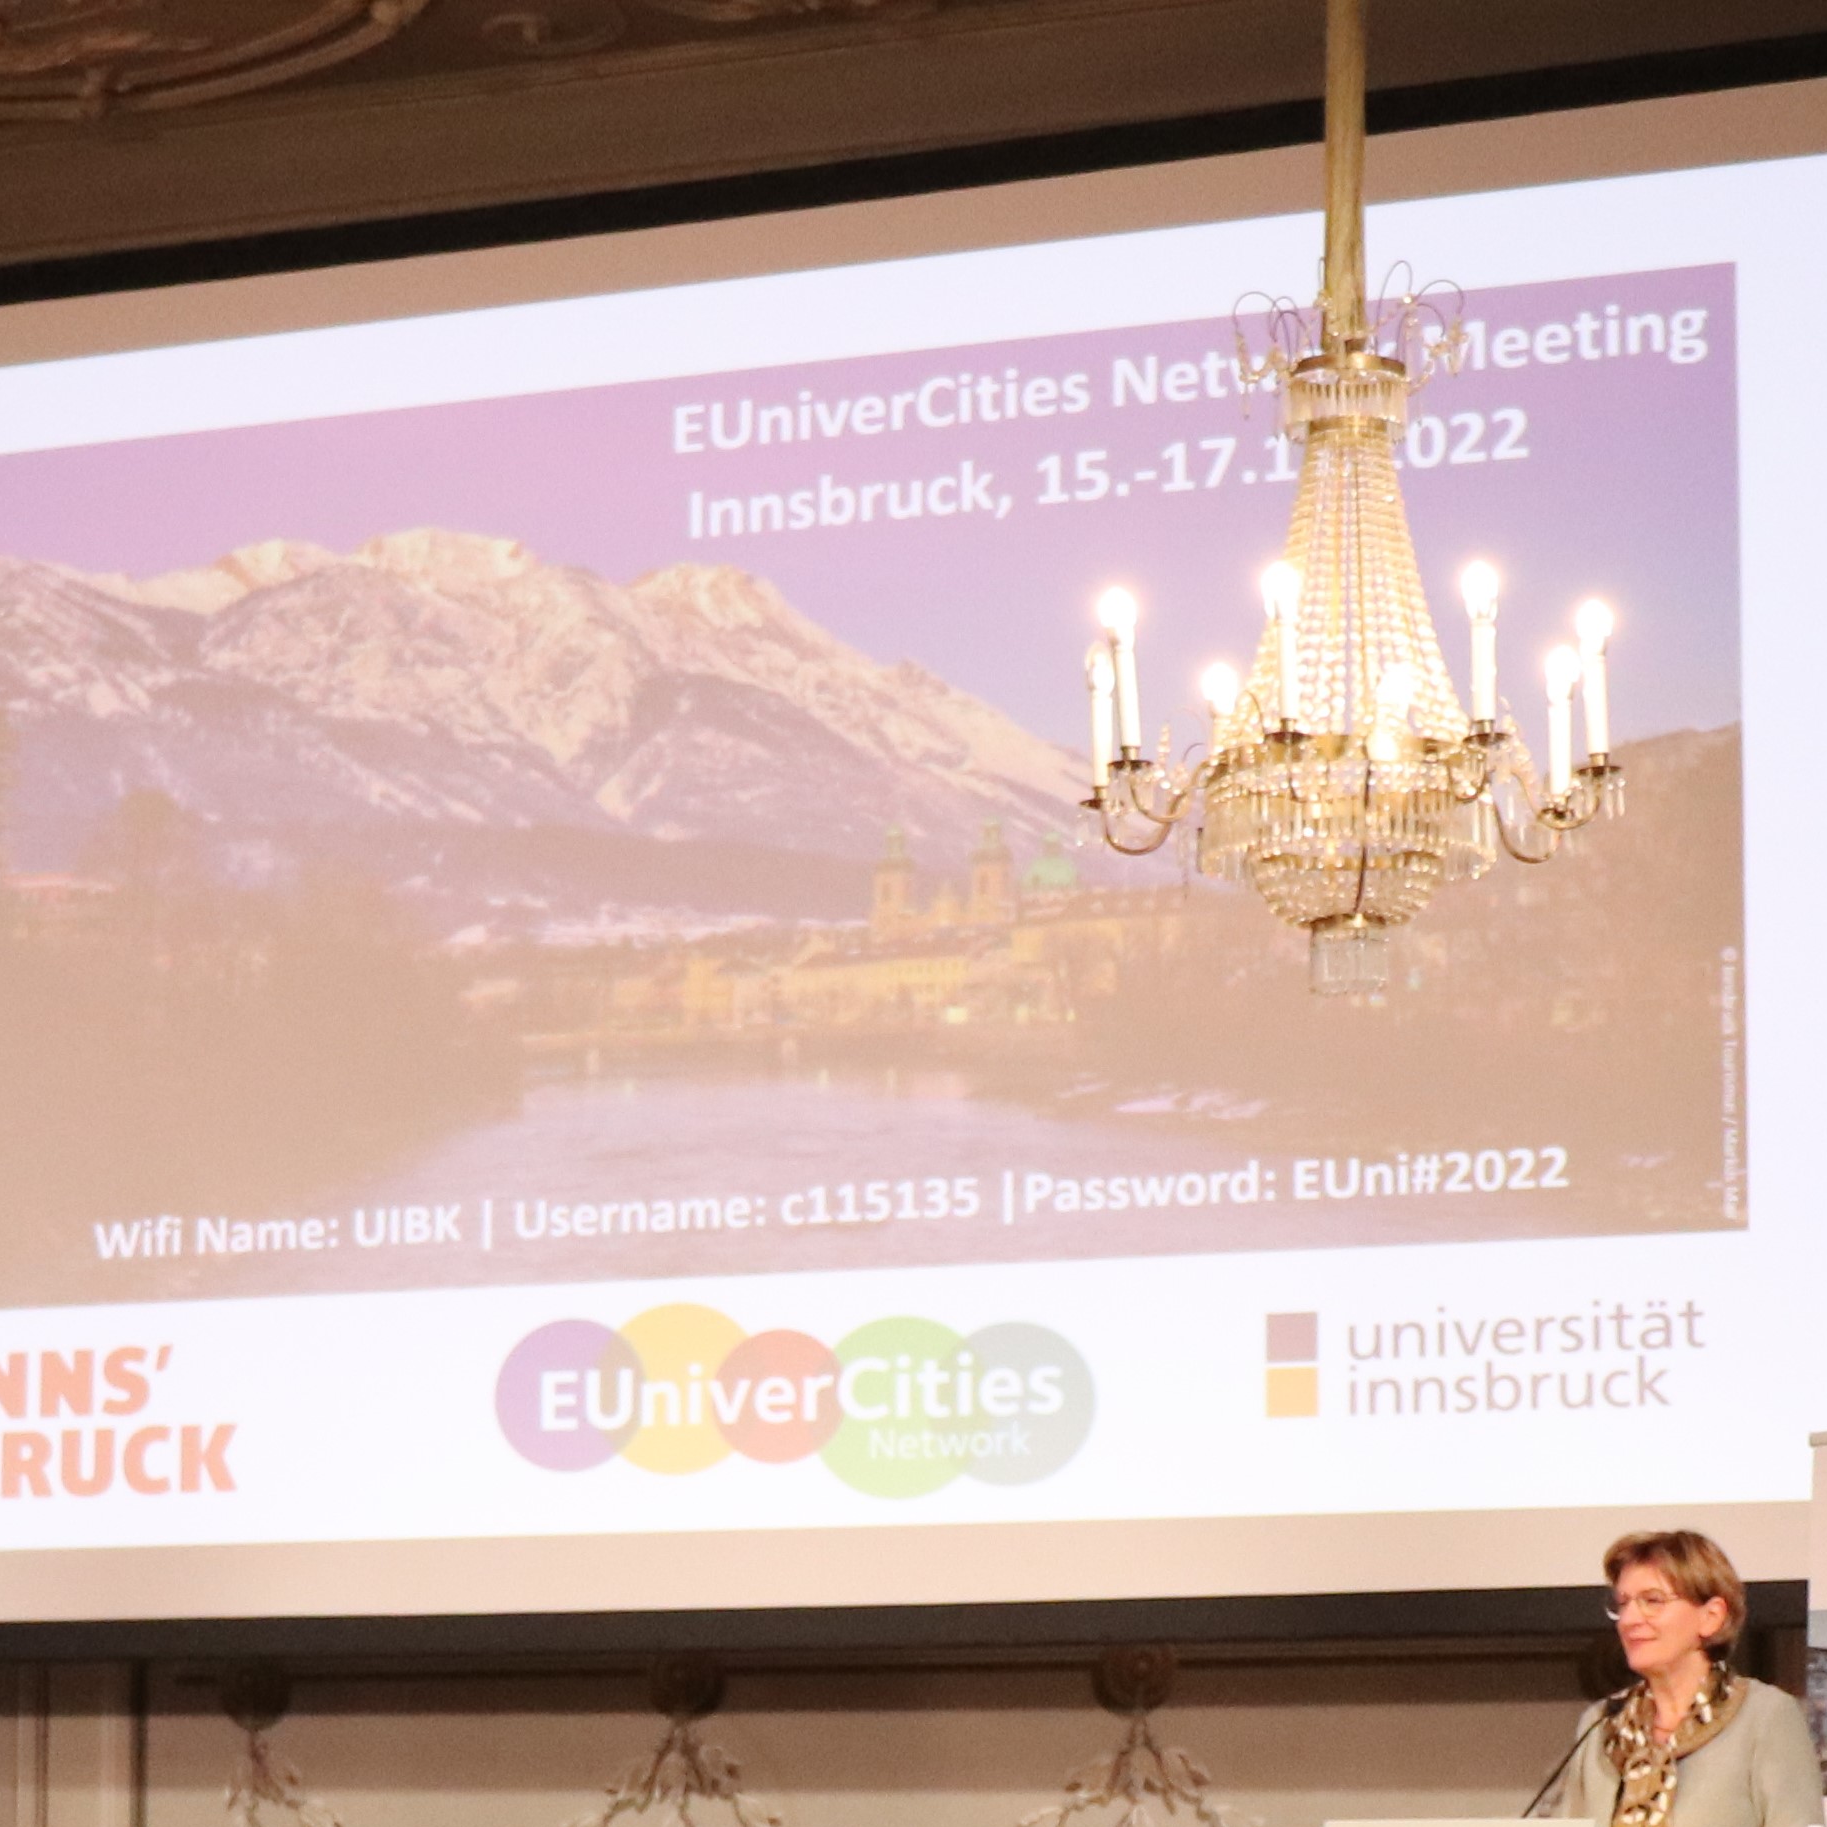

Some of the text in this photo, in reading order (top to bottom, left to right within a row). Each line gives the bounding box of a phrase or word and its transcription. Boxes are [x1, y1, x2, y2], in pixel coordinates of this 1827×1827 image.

[673, 305, 1709, 454] EUniverCities Netw Meeting
[689, 407, 1531, 539] Innsbruck, 15.-17.1022
[95, 1215, 180, 1259] Wifi
[195, 1216, 338, 1256] Name:
[353, 1204, 461, 1247] UIBK
[514, 1192, 767, 1238] Username:
[780, 1177, 979, 1228] c115135
[1293, 1146, 1569, 1202] EUni#2022
[1347, 1299, 1706, 1360] universität
[538, 1351, 1067, 1432] EUniverCities
[1348, 1356, 1671, 1416] innsbruck
[867, 1420, 1032, 1460] Network
